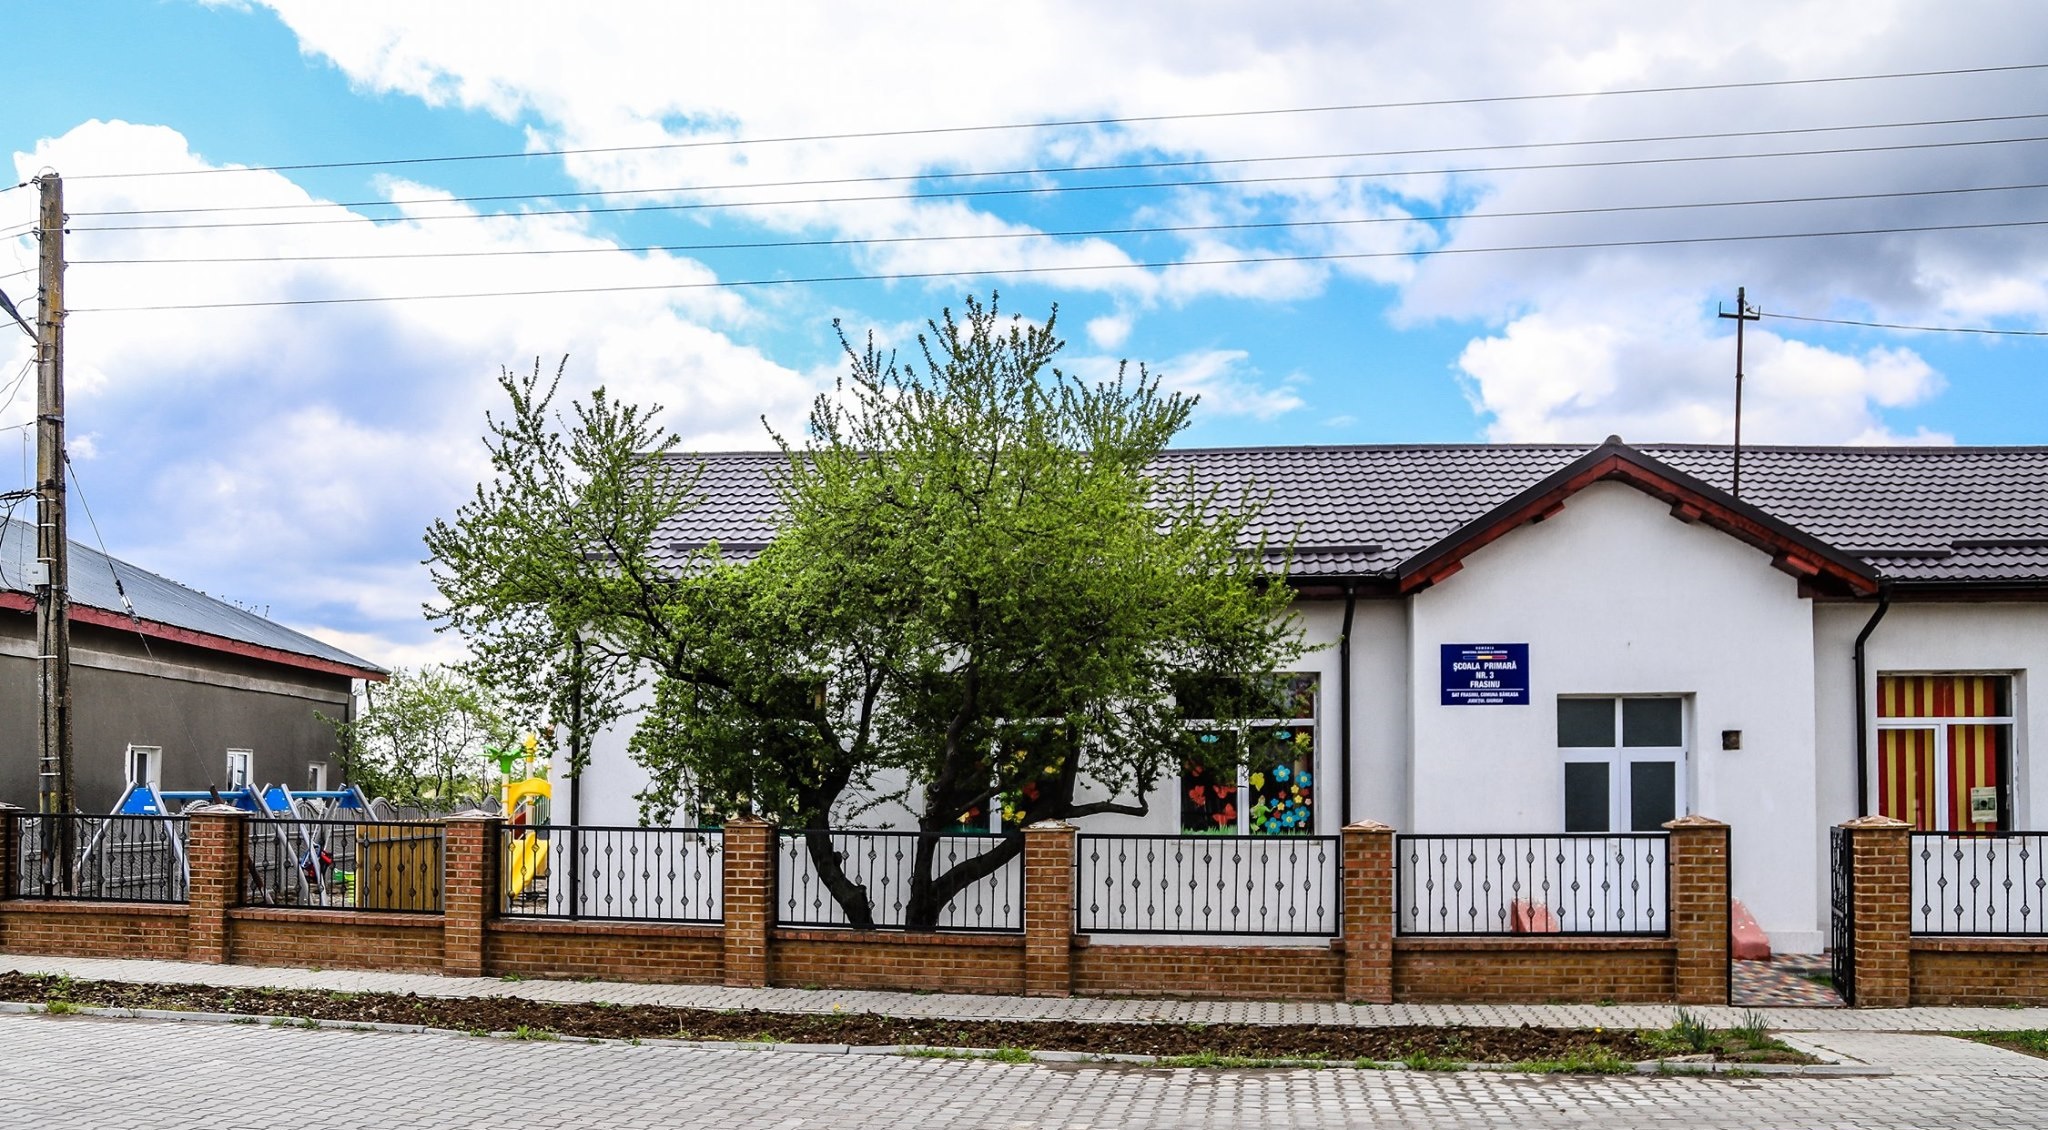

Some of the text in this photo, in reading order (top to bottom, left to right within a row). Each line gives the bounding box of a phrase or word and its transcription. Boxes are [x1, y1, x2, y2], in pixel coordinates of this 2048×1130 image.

[1484, 660, 1517, 670] PRIMARĂ
[1475, 671, 1495, 679] NR. 3
[1470, 680, 1500, 688] FRASINU
